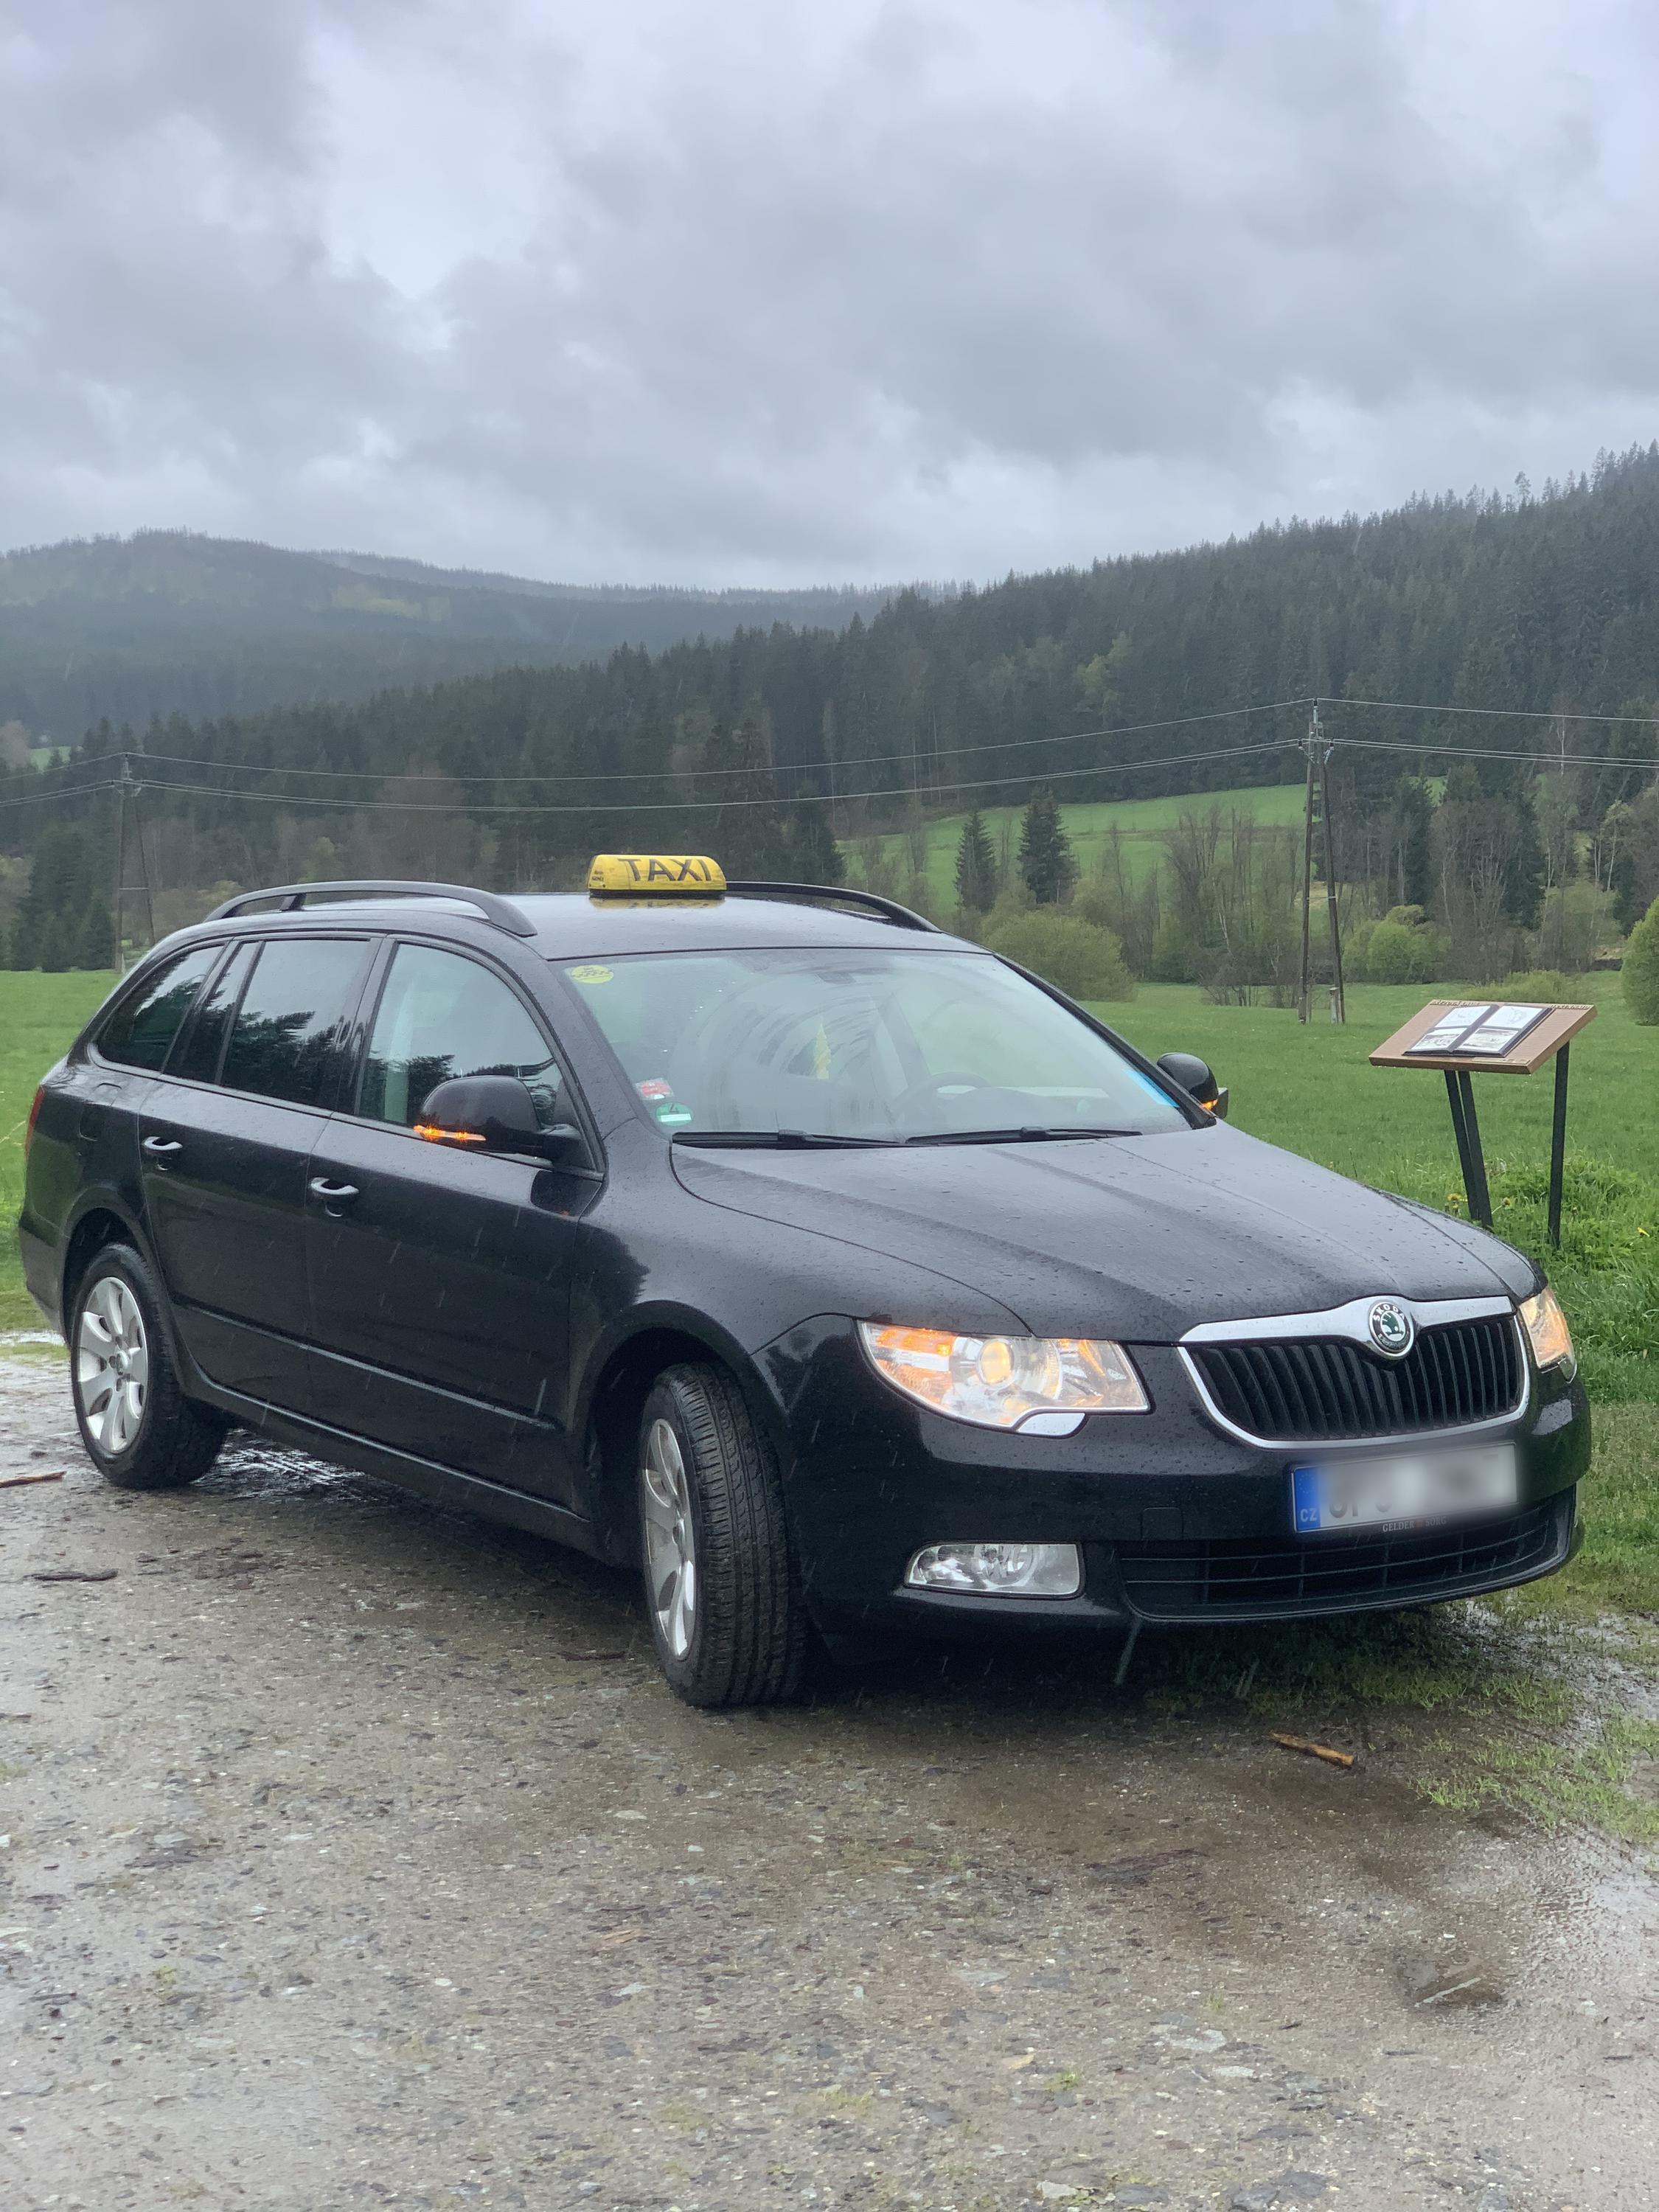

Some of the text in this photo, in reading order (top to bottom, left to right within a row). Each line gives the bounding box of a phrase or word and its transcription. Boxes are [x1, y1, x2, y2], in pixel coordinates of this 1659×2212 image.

[618, 858, 712, 882] TAXI
[1300, 1507, 1318, 1523] CZ
[1382, 1520, 1415, 1532] GELDER
